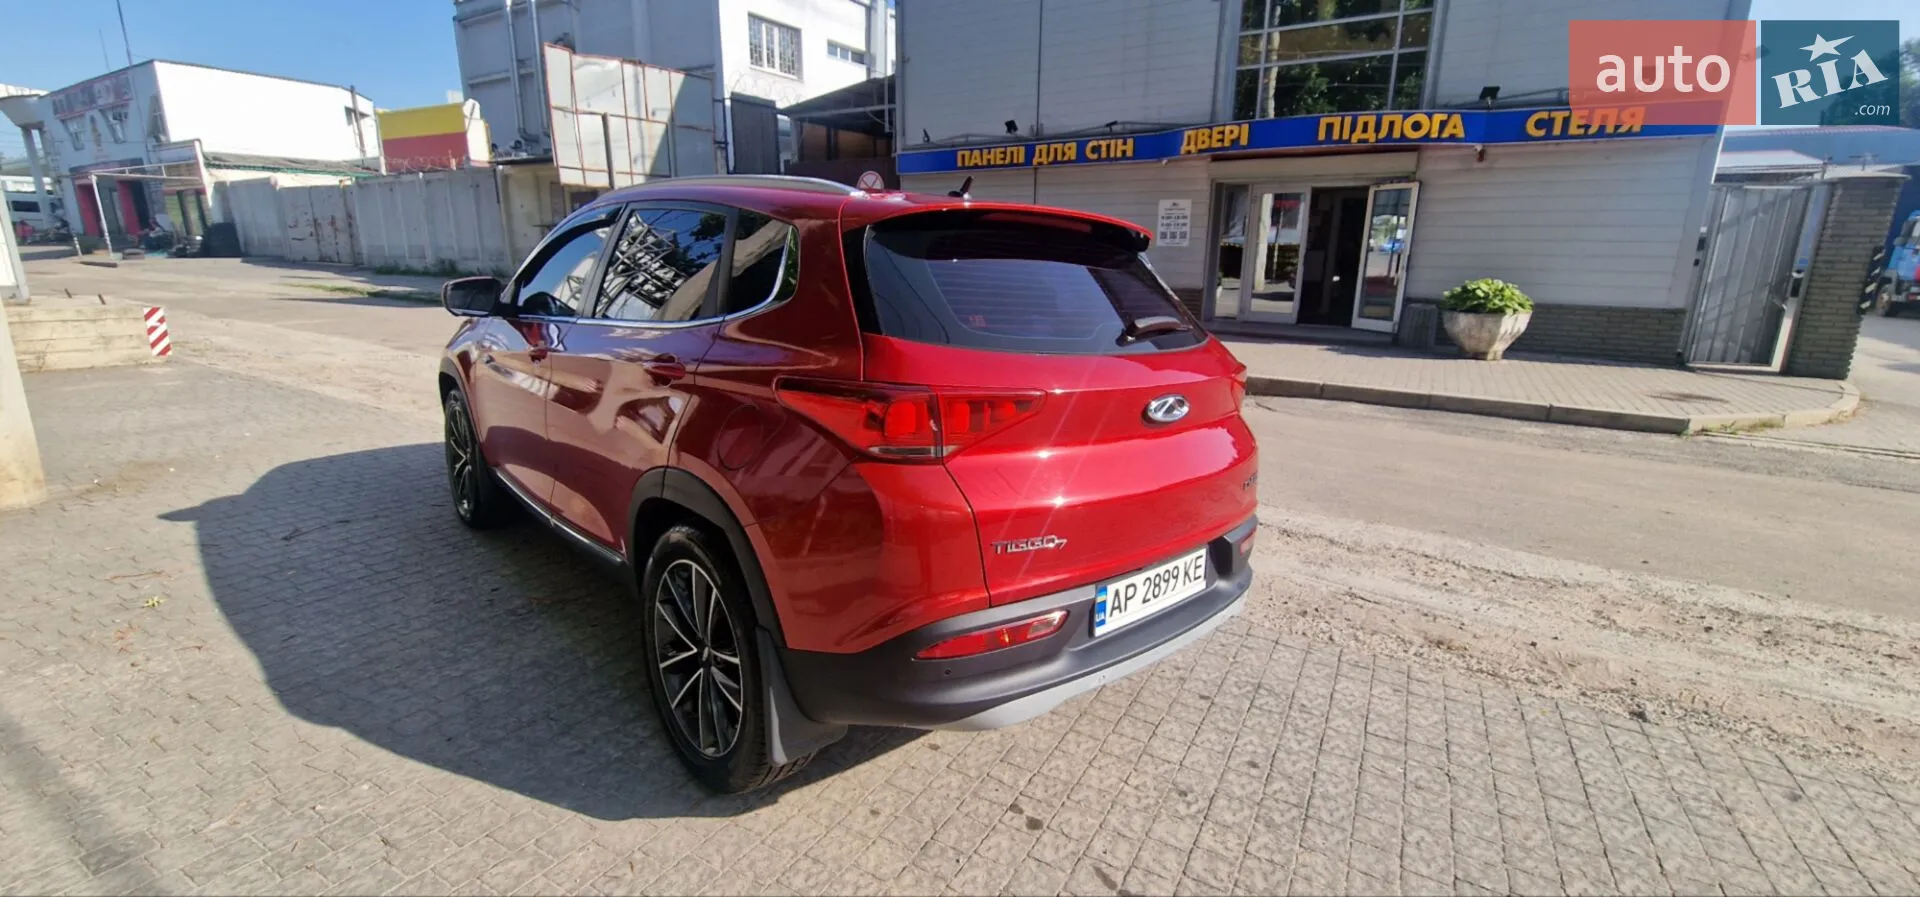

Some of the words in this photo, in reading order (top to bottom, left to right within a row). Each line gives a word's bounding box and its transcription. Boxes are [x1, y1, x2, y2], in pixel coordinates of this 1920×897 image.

[1318, 113, 1465, 143] ПІДЛОГА
[1526, 107, 1646, 137] СТЕЛЯ
[957, 146, 1025, 168] ПАНЕЛІ
[1032, 142, 1077, 165] ДЛЯ
[1085, 138, 1134, 160] СТІН
[1180, 124, 1250, 155] ДВЕРІ
[1109, 583, 1138, 617] AP
[1142, 565, 1180, 604] 2899
[1183, 555, 1203, 586] KE
